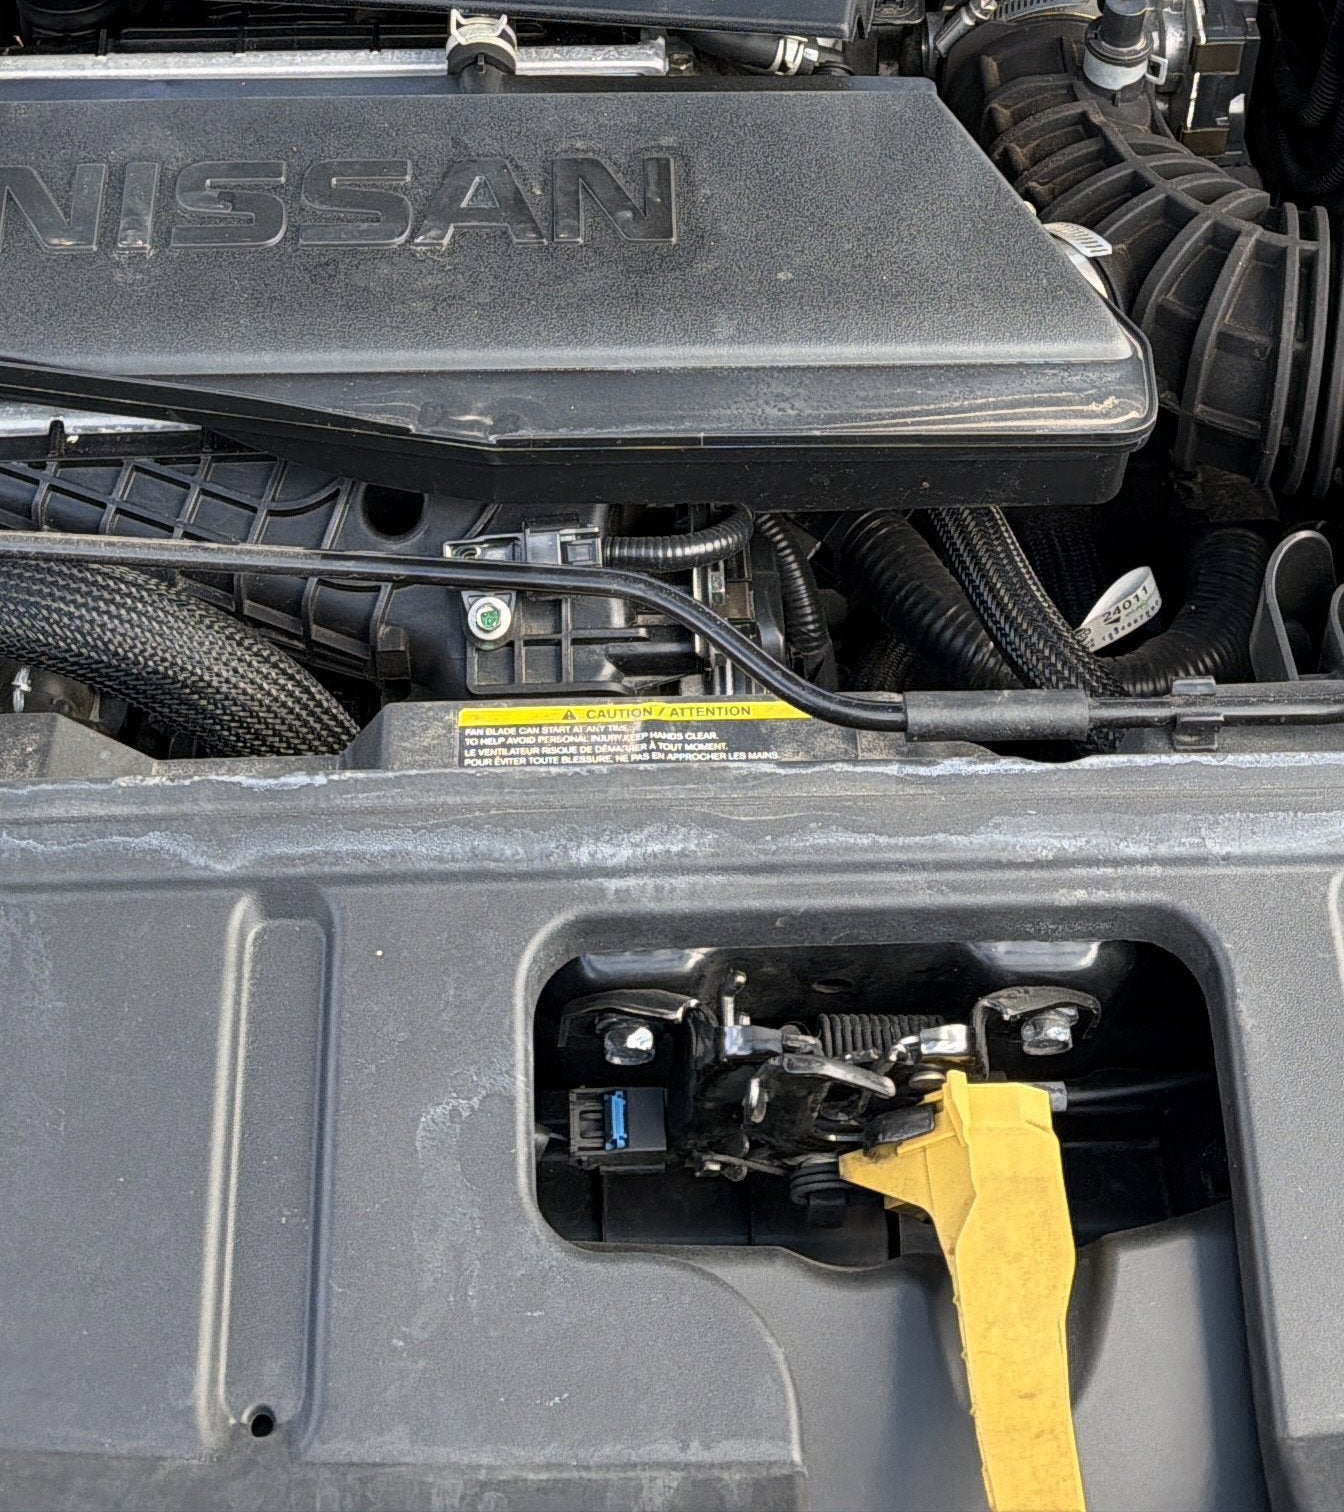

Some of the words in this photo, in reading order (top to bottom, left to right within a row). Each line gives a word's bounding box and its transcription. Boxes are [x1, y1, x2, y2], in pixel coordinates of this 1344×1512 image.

[1102, 584, 1148, 623] 24011
[585, 706, 653, 720] CAUTION
[670, 706, 751, 718] ATTENTION
[465, 728, 484, 737] FAN
[485, 727, 516, 736] BLADE
[518, 726, 540, 735] CAN
[541, 726, 571, 735] START
[465, 738, 479, 747] TO
[480, 737, 505, 746] HELP
[506, 736, 536, 745] AVOID
[538, 735, 589, 744] PERSONAL
[650, 732, 684, 741] HANDS
[464, 748, 476, 758] LE
[478, 747, 540, 757] VENTILATEUR
[542, 746, 578, 755] RISQUE
[579, 745, 593, 754] DE
[658, 742, 683, 751] TOUT
[684, 742, 729, 751] MOMENT.
[464, 758, 493, 767] POUR
[494, 755, 527, 766] ÉVITER
[528, 756, 559, 765] TOUTE
[631, 753, 651, 762] PAS
[652, 751, 665, 760] EN
[667, 752, 727, 761] APPROCHER
[728, 751, 747, 760] LES
